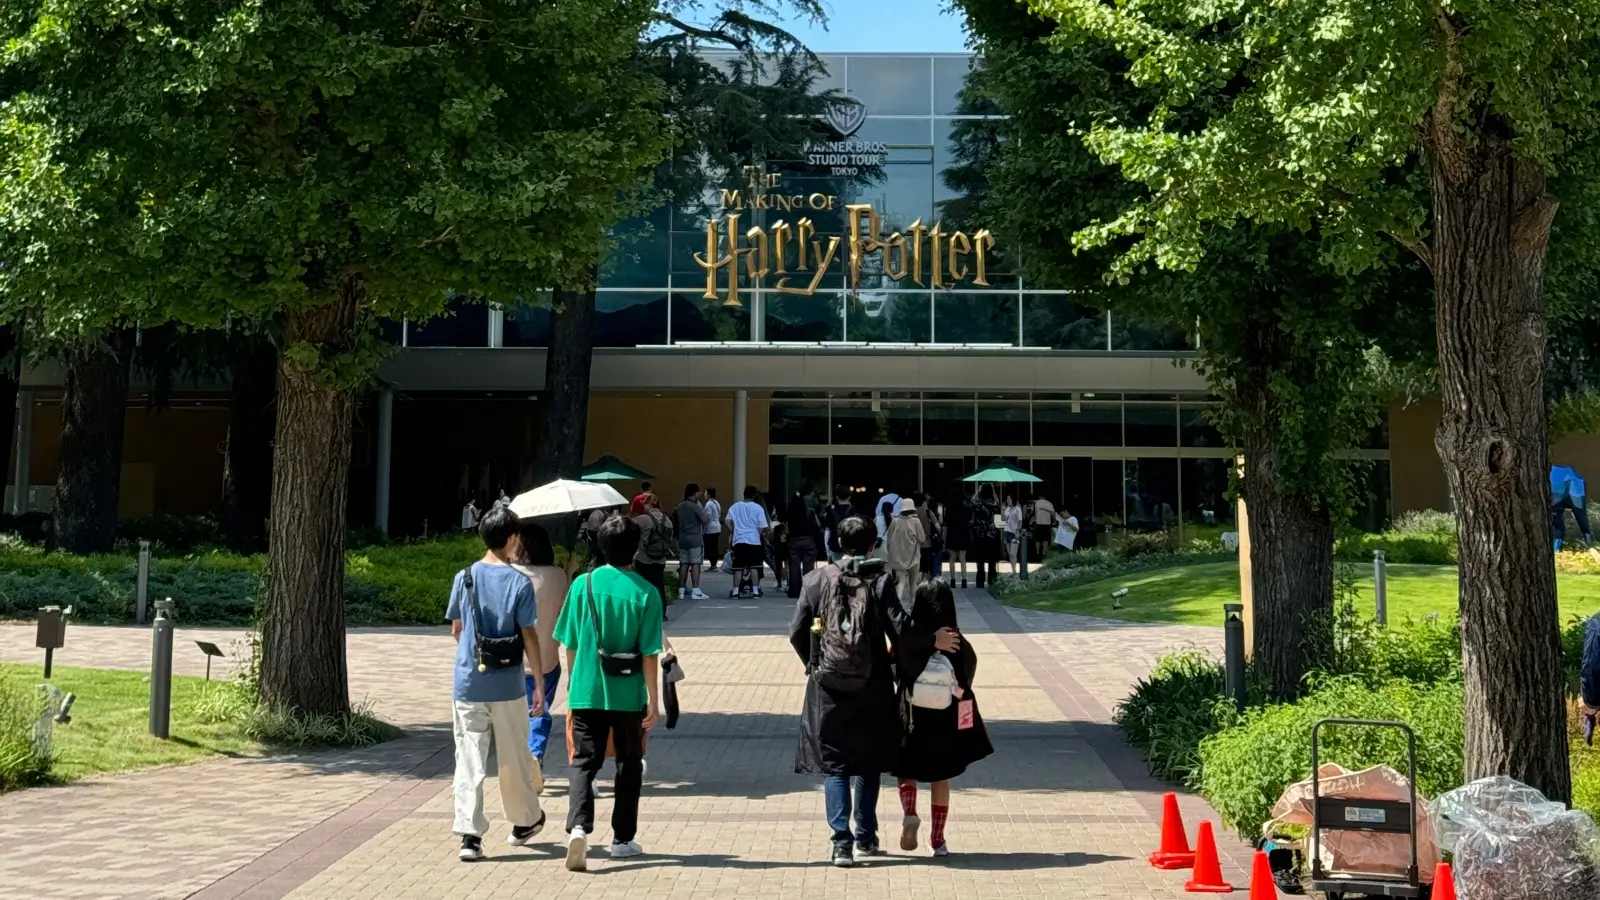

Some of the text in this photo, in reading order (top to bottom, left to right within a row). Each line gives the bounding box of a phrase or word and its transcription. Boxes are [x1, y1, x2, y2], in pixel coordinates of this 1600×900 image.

[808, 154, 880, 166] STUDIO TOUR
[831, 167, 858, 176] TOKYO
[743, 165, 781, 188] THE
[720, 188, 837, 213] MAKING OF
[693, 203, 996, 307] Harry Potter
